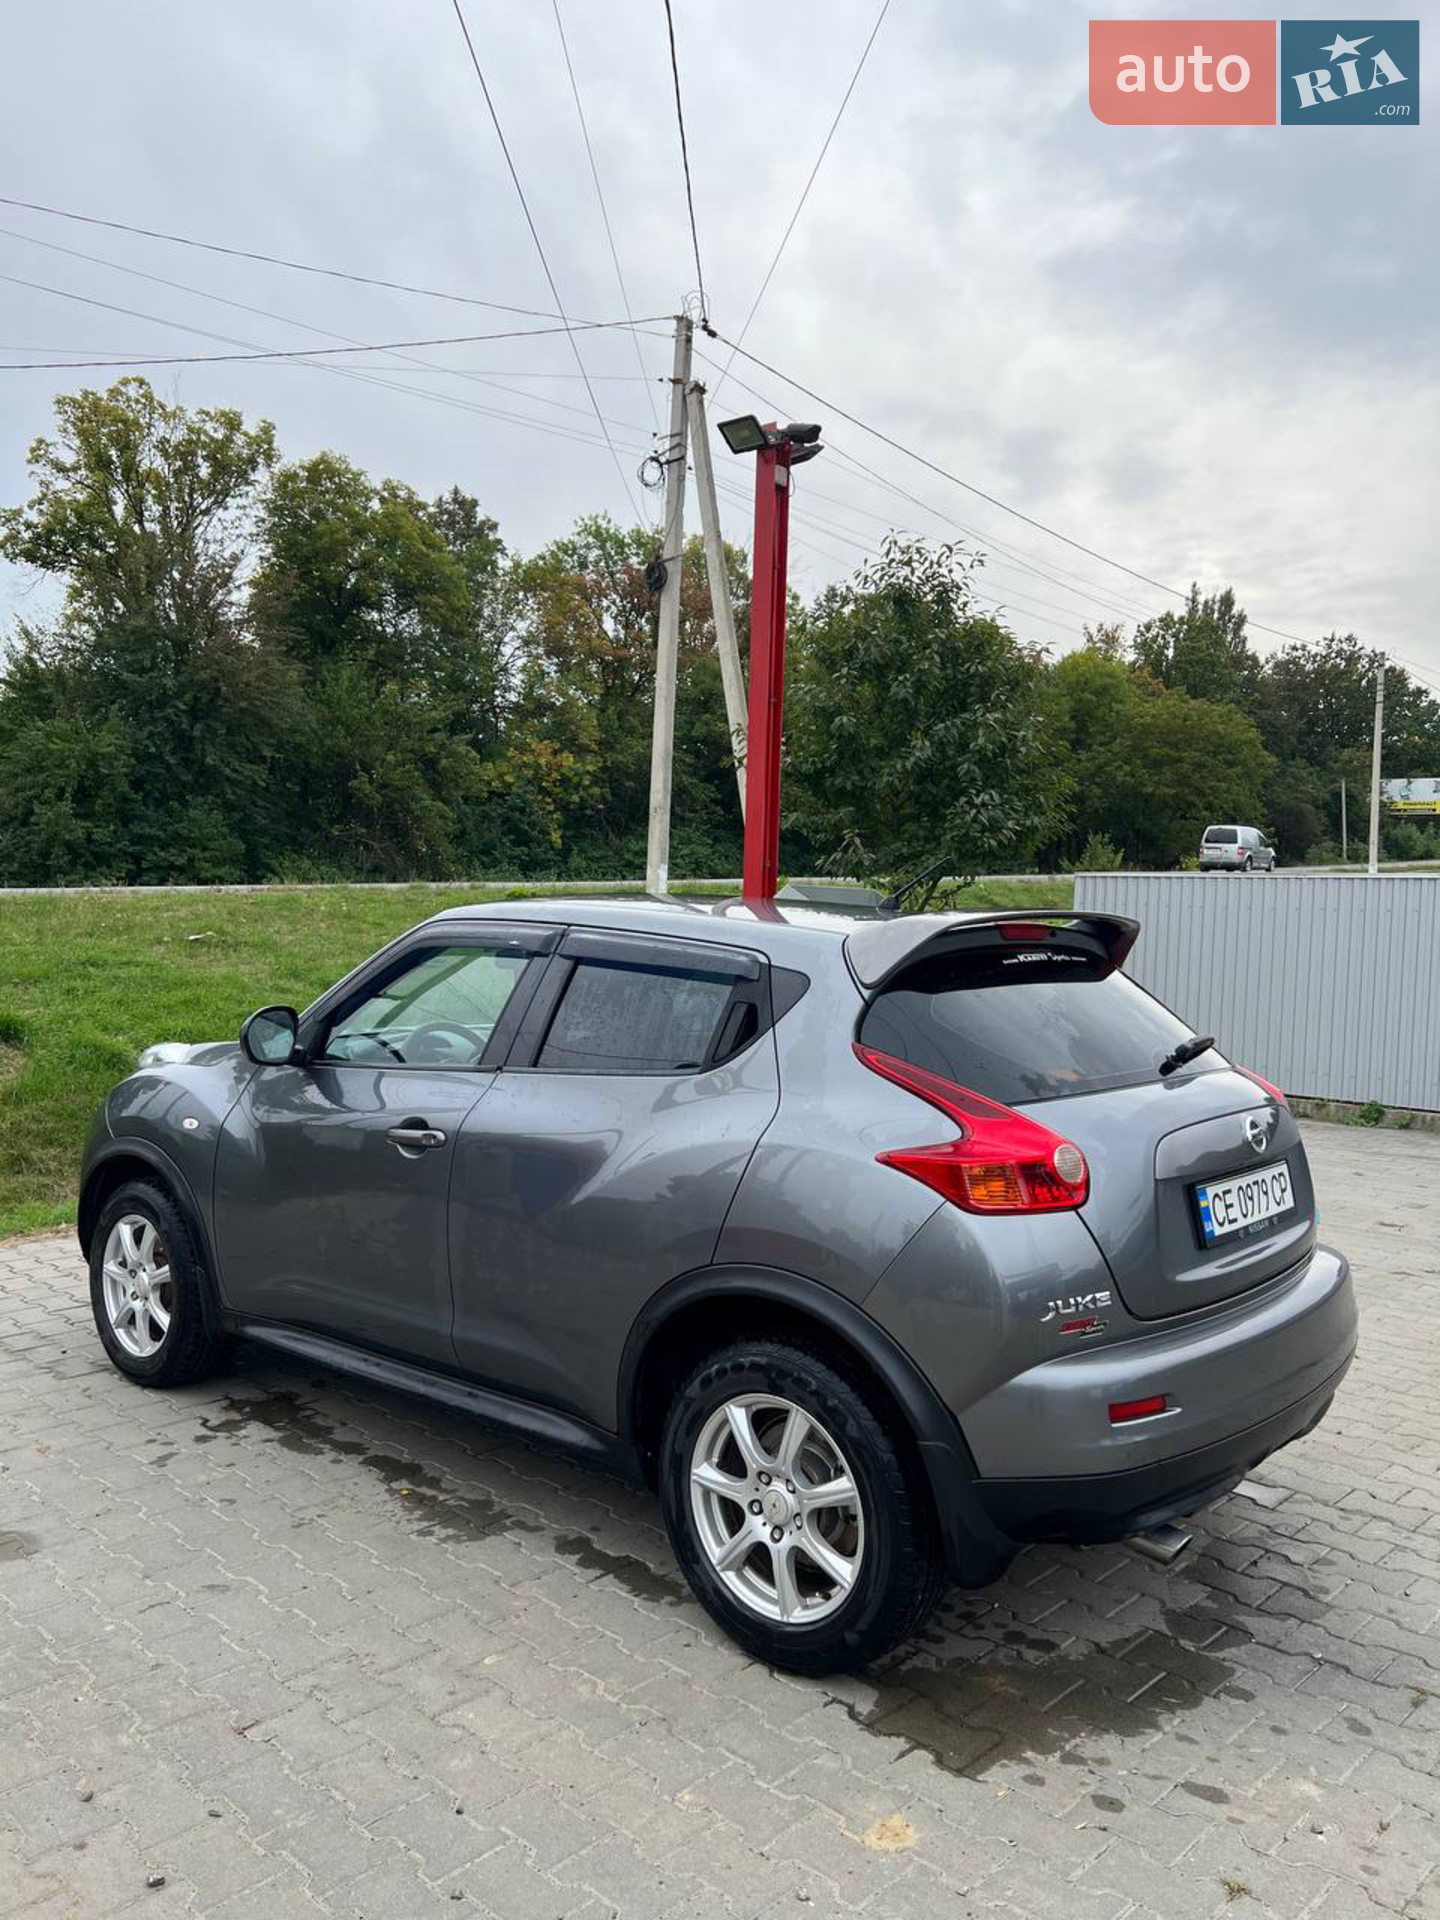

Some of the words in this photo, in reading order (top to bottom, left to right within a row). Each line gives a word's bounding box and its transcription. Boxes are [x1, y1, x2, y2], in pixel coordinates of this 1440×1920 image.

[1211, 1187, 1238, 1228] CE
[1237, 1178, 1270, 1219] 0979
[1271, 1171, 1288, 1207] CP
[1039, 1290, 1113, 1323] JUKE
